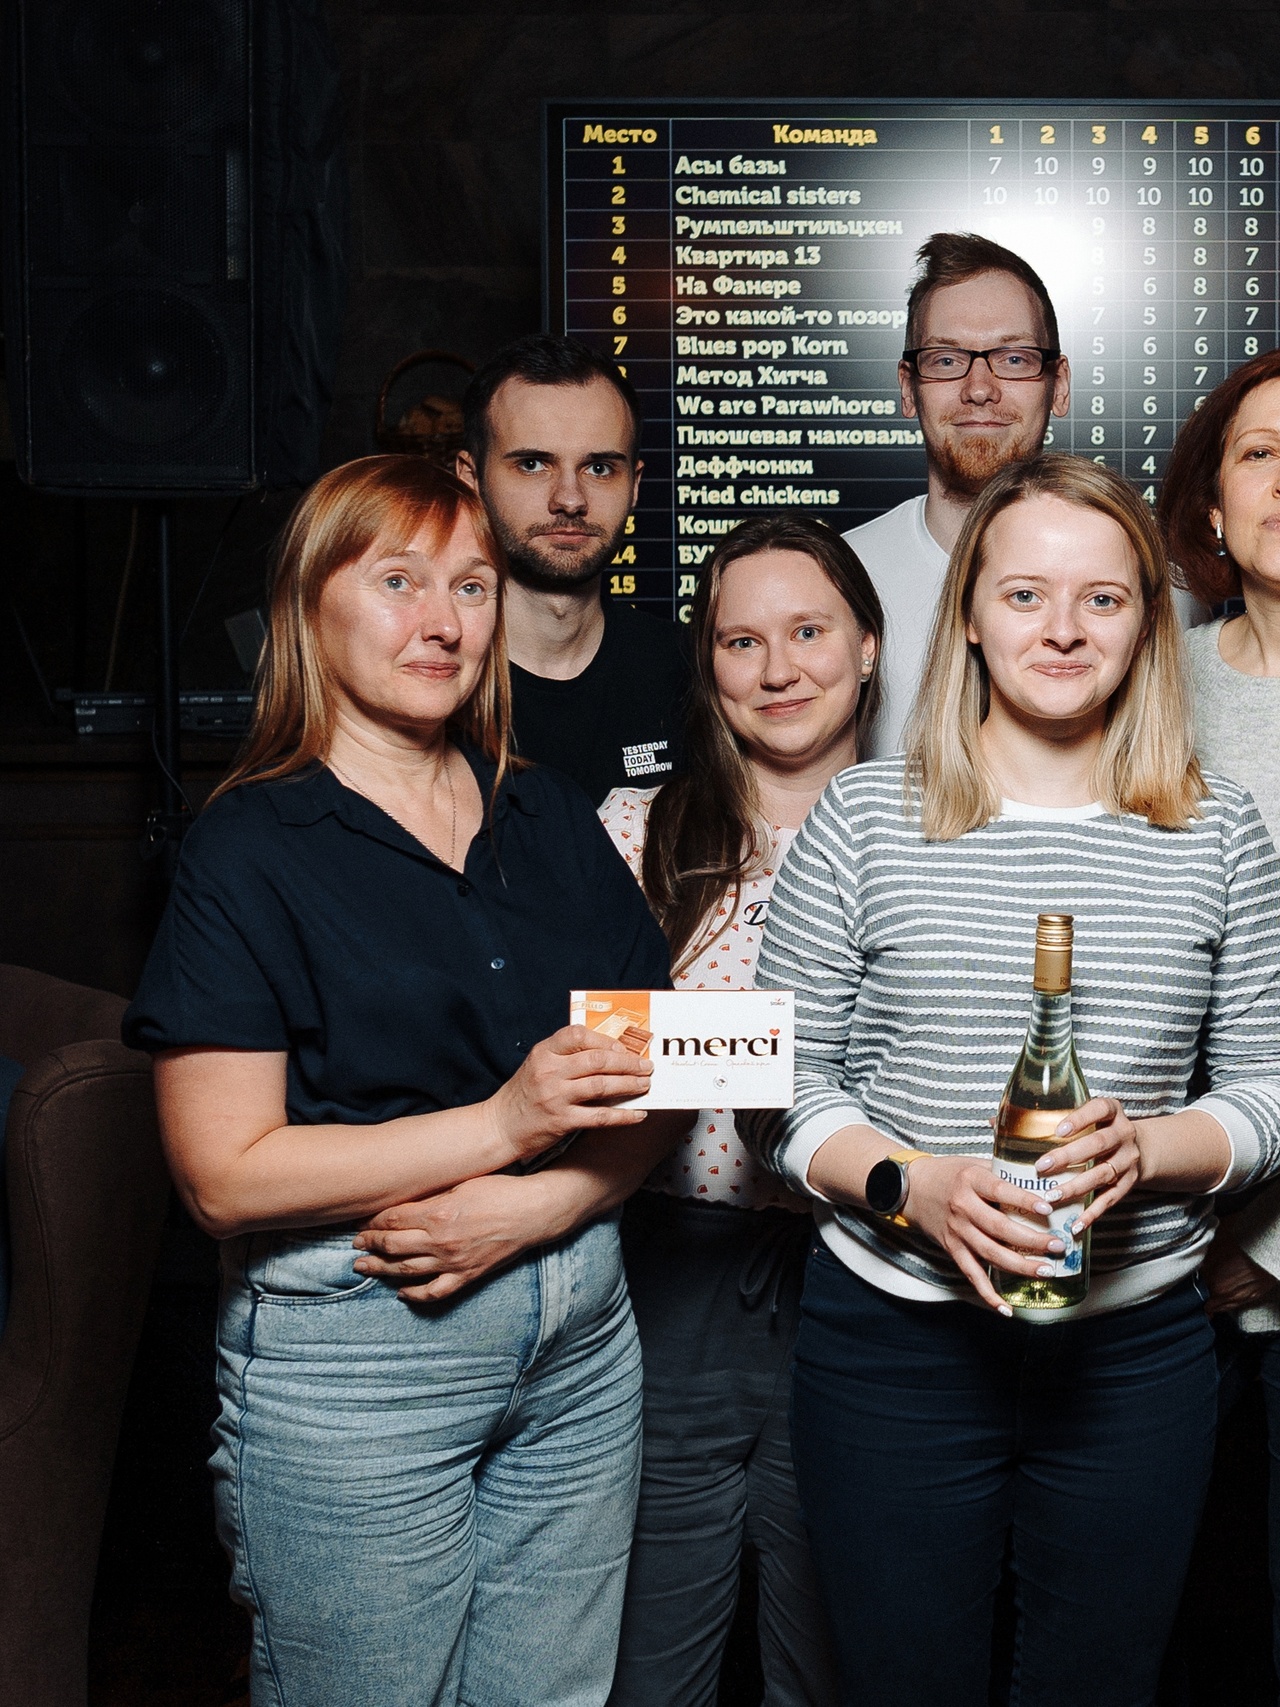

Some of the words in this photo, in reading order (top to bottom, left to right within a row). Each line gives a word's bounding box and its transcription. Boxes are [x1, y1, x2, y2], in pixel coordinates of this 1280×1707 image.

[583, 125, 657, 143] Место
[773, 125, 877, 146] Команда
[990, 126, 1003, 143] 1
[1041, 126, 1055, 143] 2
[1092, 126, 1105, 144] 3
[1142, 126, 1157, 144] 4
[1195, 127, 1208, 144] 5
[1246, 127, 1260, 144] 6
[613, 156, 625, 174] 1
[675, 156, 723, 174] Асы
[729, 155, 786, 174] базы
[989, 157, 1001, 174] 7
[1034, 157, 1058, 174] 10
[1092, 158, 1104, 175] 9
[1144, 158, 1156, 175] 9
[1189, 158, 1212, 175] 10
[1240, 158, 1263, 175] 10
[612, 186, 625, 204] 2
[676, 186, 781, 204] Chemical
[787, 186, 861, 204] sisters
[983, 187, 1007, 205] 10
[1035, 187, 1058, 205] 10
[1086, 187, 1110, 205] 10
[1137, 188, 1161, 205] 10
[1189, 188, 1212, 205] 10
[1240, 188, 1263, 205] 10
[612, 217, 625, 234] 3
[676, 217, 903, 237] Румпельштильцхен
[1092, 217, 1106, 236] 9
[1142, 217, 1156, 235] 8
[1194, 218, 1207, 235] 8
[1245, 218, 1258, 235] 8
[612, 247, 626, 264] 4
[676, 246, 789, 267] Квартира
[795, 246, 821, 264] 13
[1143, 248, 1156, 265] 5
[1194, 248, 1206, 265] 8
[1246, 248, 1258, 265] 7
[613, 277, 625, 294] 5
[676, 276, 707, 294] На
[713, 276, 801, 297] Фанере
[1143, 277, 1157, 295] 6
[1194, 277, 1207, 295] 8
[1246, 277, 1259, 295] 6
[613, 306, 626, 324] 6
[676, 306, 720, 324] Это
[726, 306, 832, 324] какой-то
[838, 310, 907, 327] позор
[1092, 307, 1105, 325] 7
[1143, 307, 1157, 325] 5
[1194, 307, 1207, 325] 7
[1245, 307, 1258, 325] 7
[614, 336, 627, 354] 7
[676, 336, 736, 354] Blues
[742, 340, 787, 357] pop
[792, 336, 848, 354] Korn
[1092, 337, 1104, 354] 5
[1144, 337, 1156, 354] 6
[1195, 337, 1208, 355] 6
[1245, 337, 1258, 355] 8
[677, 366, 753, 387] Метод
[758, 366, 828, 384] Хитча
[1093, 367, 1104, 384] 5
[1144, 367, 1156, 384] 5
[1194, 367, 1207, 385] 7
[677, 396, 714, 414] We
[719, 400, 756, 414] are
[761, 396, 895, 414] Parawhores
[1091, 396, 1104, 414] 8
[1144, 396, 1157, 414] 6
[677, 426, 802, 444] Плюшевая
[1091, 426, 1104, 444] 8
[1143, 426, 1156, 444] 7
[677, 456, 813, 477] Деффчонки
[1142, 456, 1156, 474] 4
[678, 486, 735, 504] Fried
[740, 486, 839, 504] chickens
[1143, 485, 1156, 504] 4
[611, 576, 635, 593] 15
[622, 740, 668, 756] YESTERDAY
[625, 754, 653, 767] TODAY
[625, 761, 673, 777] TOMORROW
[662, 1028, 780, 1057] merci
